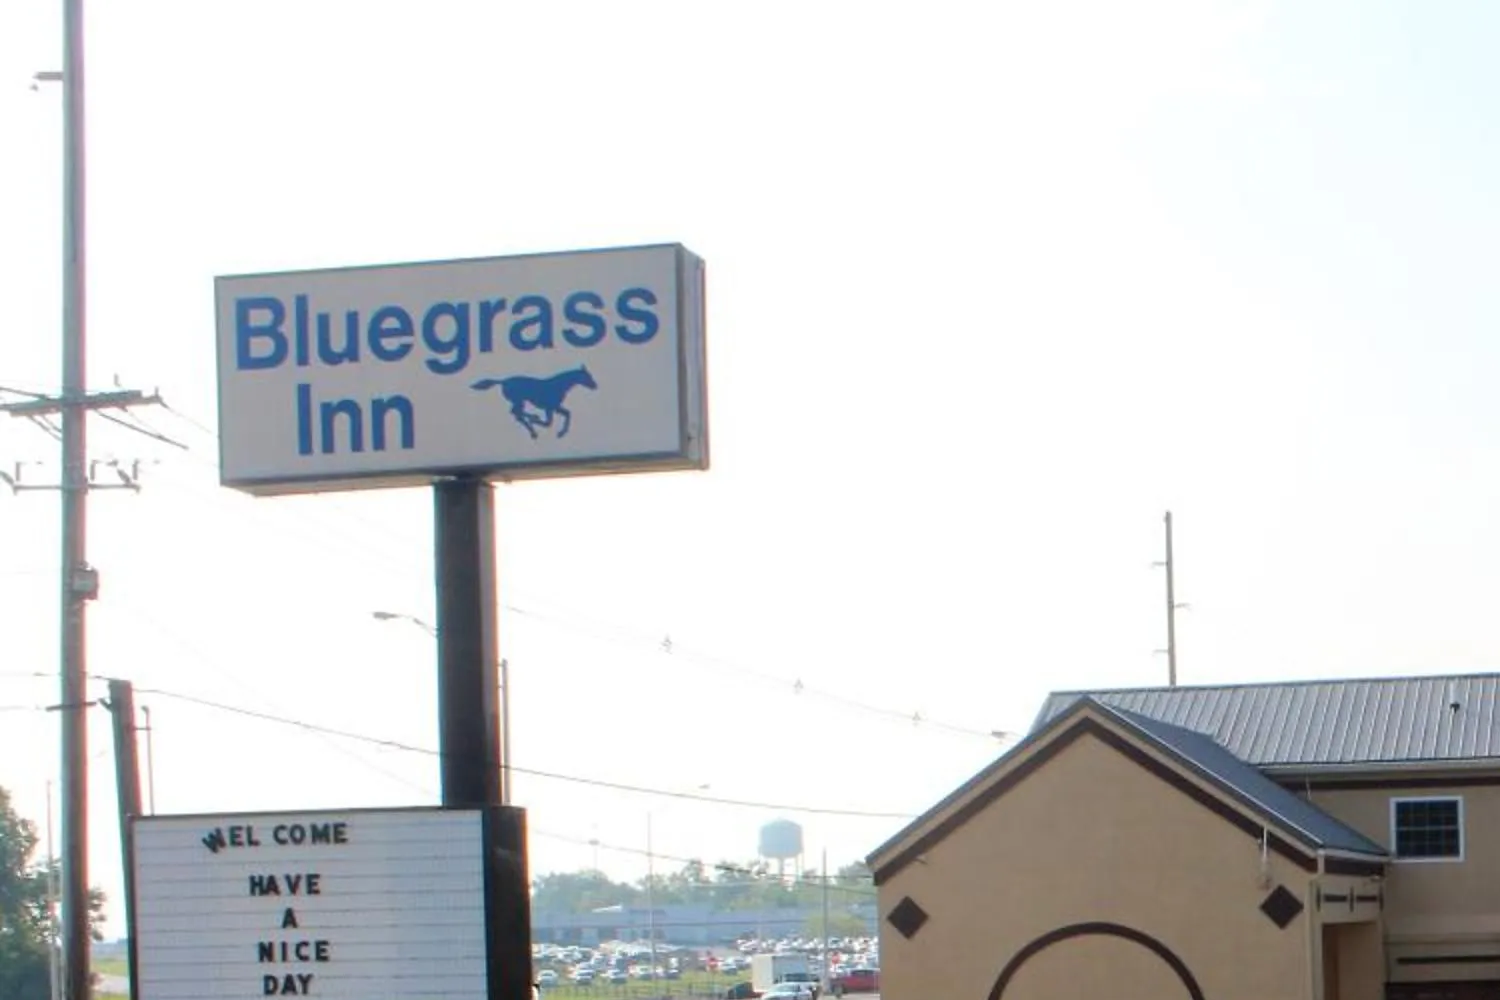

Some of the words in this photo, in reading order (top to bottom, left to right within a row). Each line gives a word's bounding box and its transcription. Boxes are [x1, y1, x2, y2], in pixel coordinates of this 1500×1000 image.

[235, 287, 660, 376] Bluegrass
[297, 383, 415, 456] Inn
[249, 873, 322, 897] HAVE
[281, 907, 299, 930] A
[258, 940, 331, 963] NICE
[262, 973, 315, 997] DAY
